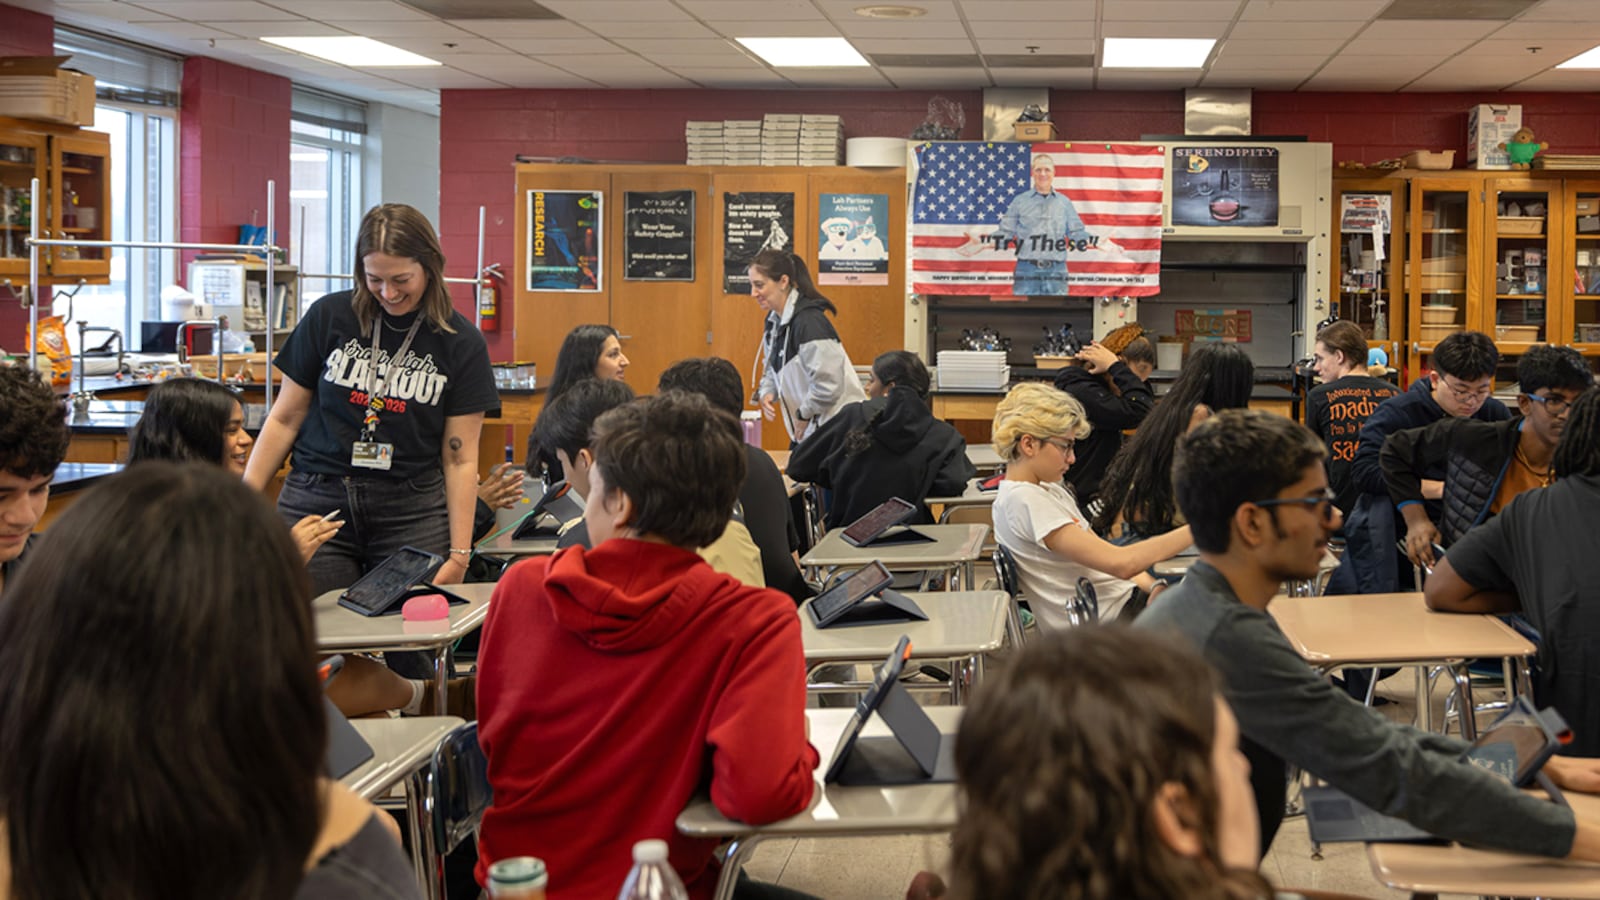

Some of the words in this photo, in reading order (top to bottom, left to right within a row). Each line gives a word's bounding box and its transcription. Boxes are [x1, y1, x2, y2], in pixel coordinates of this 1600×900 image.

[1175, 148, 1275, 157] SERENDIPITY
[832, 196, 845, 204] Lab
[846, 196, 874, 205] Partners
[835, 205, 858, 213] Always
[535, 192, 545, 256] RESEARCH
[980, 235, 1024, 256] "Try
[1030, 234, 1099, 252] These"
[324, 348, 448, 406] BLACKOUT
[1329, 397, 1380, 420] madn
